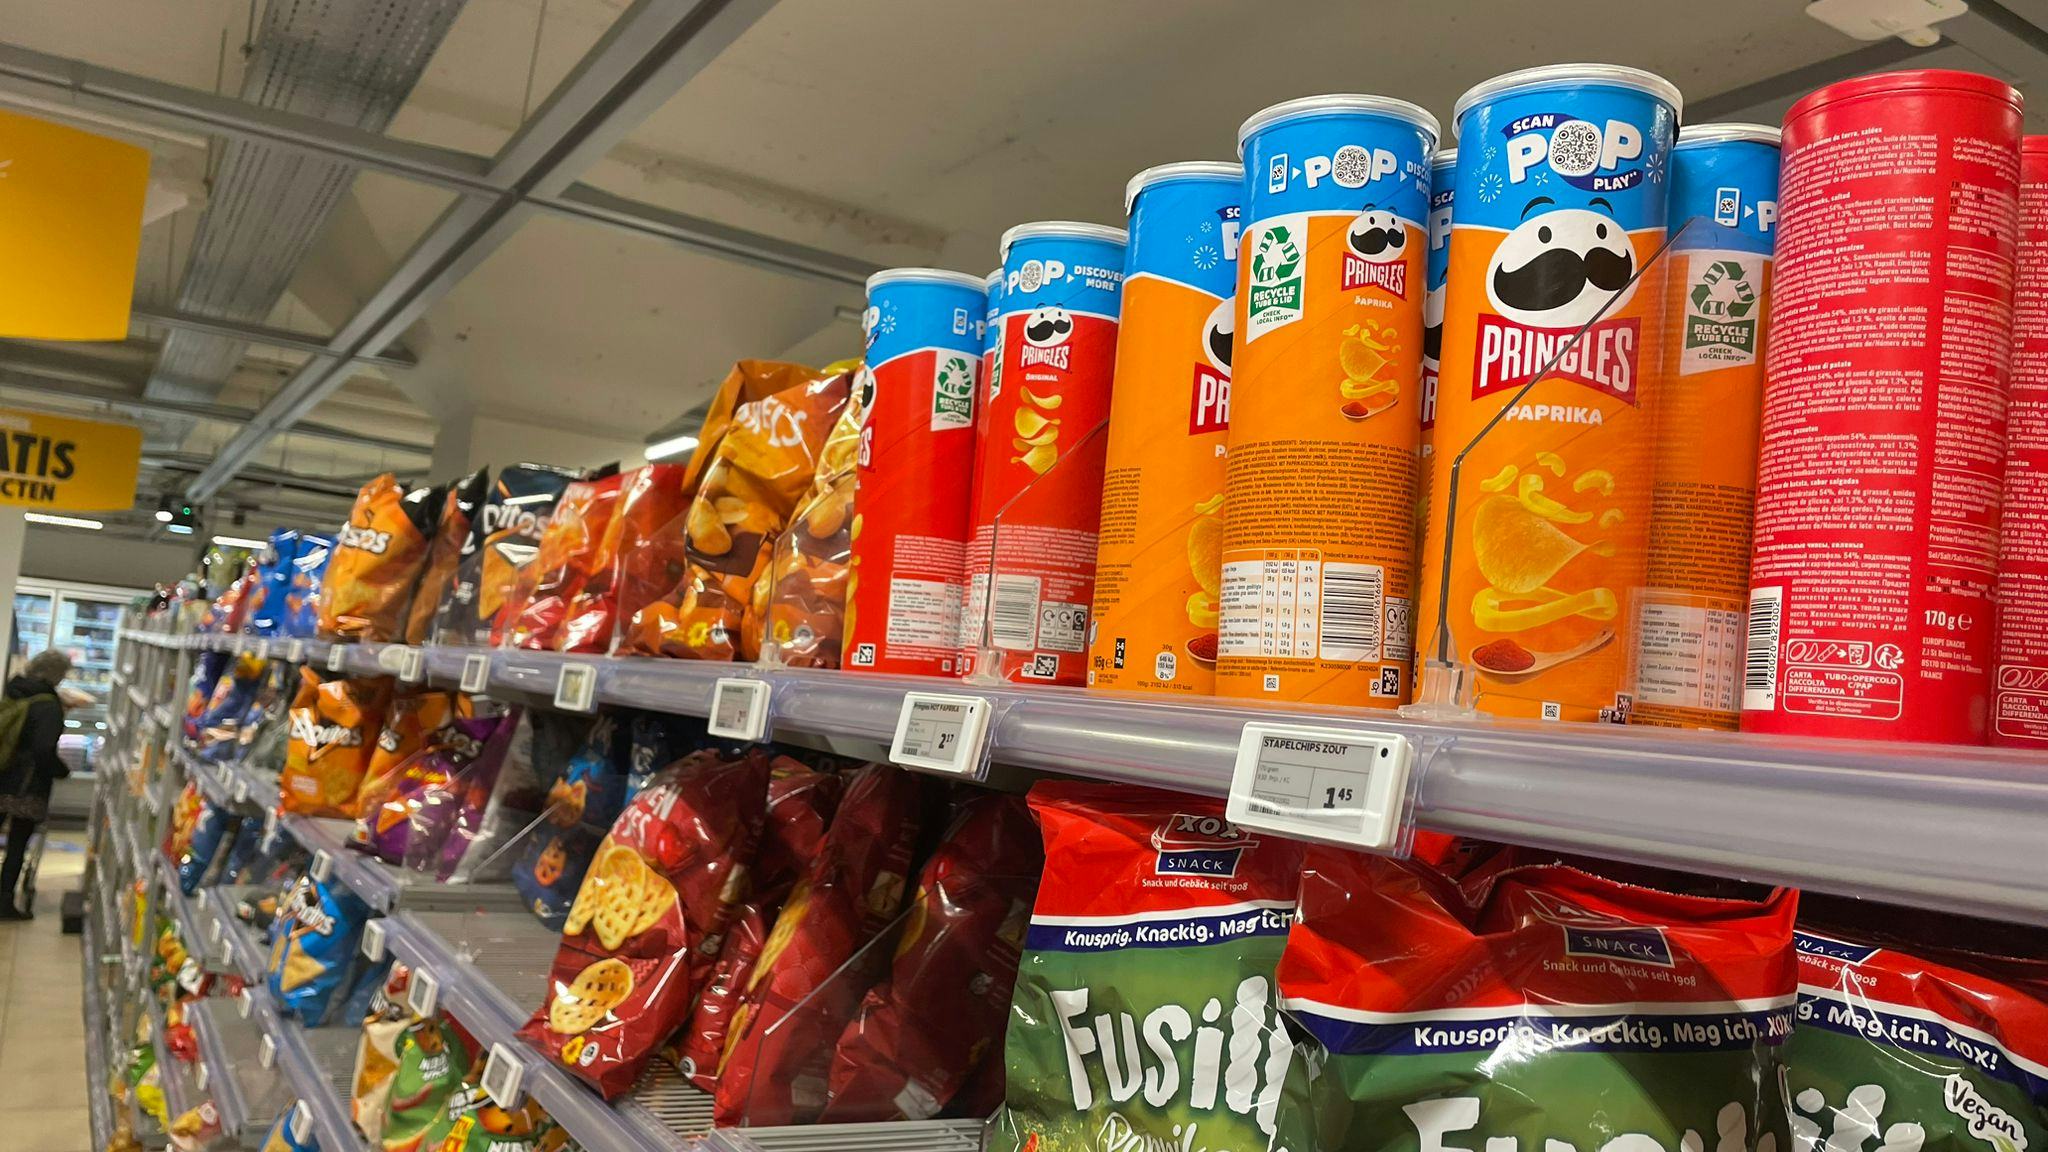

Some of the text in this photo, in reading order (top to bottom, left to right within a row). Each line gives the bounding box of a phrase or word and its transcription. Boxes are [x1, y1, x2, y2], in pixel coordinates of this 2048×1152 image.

[1512, 115, 1554, 134] SCAN
[1304, 145, 1398, 189] POP
[1406, 161, 1431, 181] DISCO
[1416, 182, 1430, 196] MO
[1226, 207, 1240, 219] SC
[1008, 260, 1065, 296] POP
[1345, 257, 1405, 295] PRINGLES
[1086, 278, 1115, 291] MORE
[1254, 286, 1296, 301] RECYCLE
[1255, 298, 1272, 308] TUBE
[1279, 295, 1293, 305] LID
[1354, 295, 1393, 309] PAPRIKA
[1256, 317, 1272, 325] LOCAL
[1262, 309, 1281, 318] CHECK
[1694, 324, 1749, 338] RECYCLE
[1696, 333, 1722, 343] TUBE
[1730, 335, 1746, 344] LID
[1021, 345, 1070, 370] PRINGLES
[1708, 347, 1732, 355] CHECK
[1479, 324, 1633, 394] PRINGLES
[1505, 404, 1603, 426] PAPRIKA
[1770, 601, 1780, 642] 822002
[1924, 610, 1946, 627] 170
[1947, 614, 1956, 630] g
[1768, 643, 1778, 685] 760020
[1789, 671, 1812, 679] CARTA
[1824, 672, 1898, 685] TUBO+OPERCOLO
[1920, 670, 1943, 681] FRANCE
[1789, 679, 1826, 687] RACCOLTA
[1848, 682, 1873, 690] C/PAP
[1788, 686, 1846, 696] DIFFERENZIATA
[2002, 703, 2040, 712] RACCOLTA
[2003, 696, 2028, 704] CARTA
[1263, 739, 1348, 755] STAPELCHIPS ZOUT
[1177, 815, 1239, 839] XOX
[1168, 857, 1223, 871] SNACK
[1142, 878, 1248, 892] Snack und Gebäck seit 1908
[1065, 929, 1132, 949] Knusprig.
[1136, 924, 1215, 946] Knackig.
[1219, 916, 1256, 937] Mag
[1582, 935, 1656, 958] SNACK
[1794, 937, 1854, 959] NACK
[1797, 954, 1828, 971] ebäck
[1542, 958, 1697, 987] Snack und Gebäck seit 1908
[1551, 1018, 1668, 1046] Knackig.
[1673, 1020, 1721, 1047] Mag
[1723, 1018, 1764, 1040] ich.
[1827, 1006, 1999, 1071] Mag ich. XOX!
[1952, 1077, 2018, 1140] Vegan
